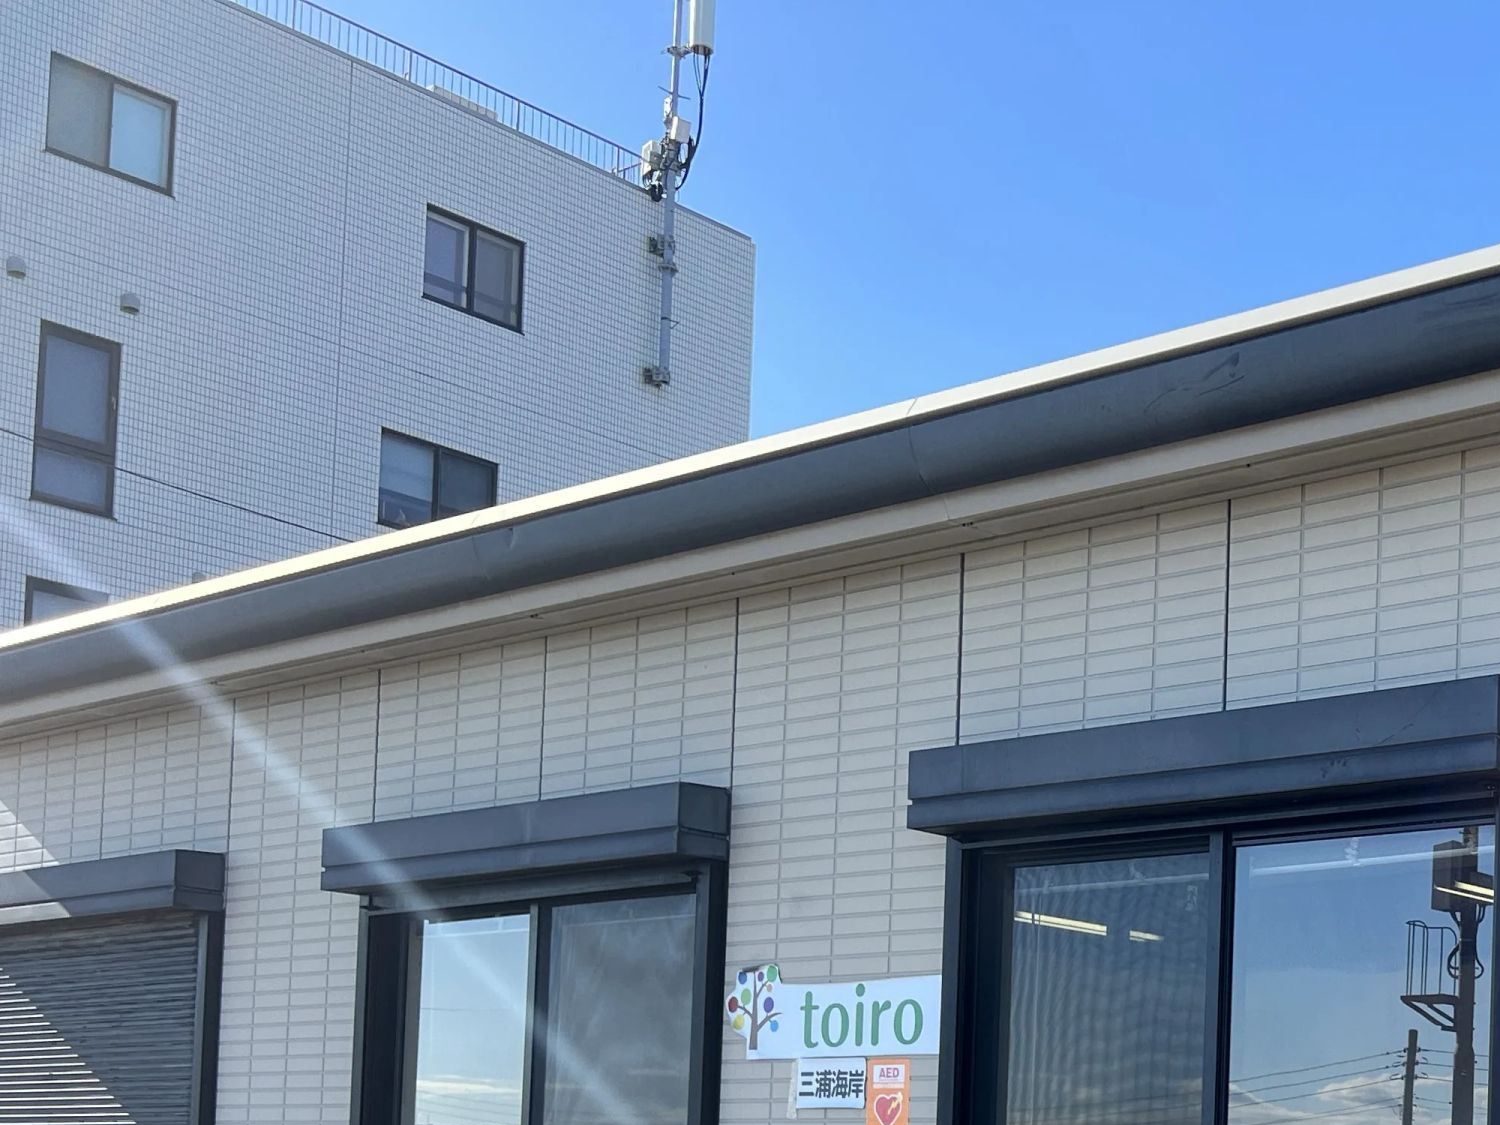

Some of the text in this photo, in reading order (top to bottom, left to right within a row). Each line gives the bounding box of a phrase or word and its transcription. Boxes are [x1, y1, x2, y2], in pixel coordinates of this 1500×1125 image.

[800, 983, 924, 1048] toiro
[798, 1069, 865, 1099] 三浦海岸
[879, 1067, 900, 1079] AED
